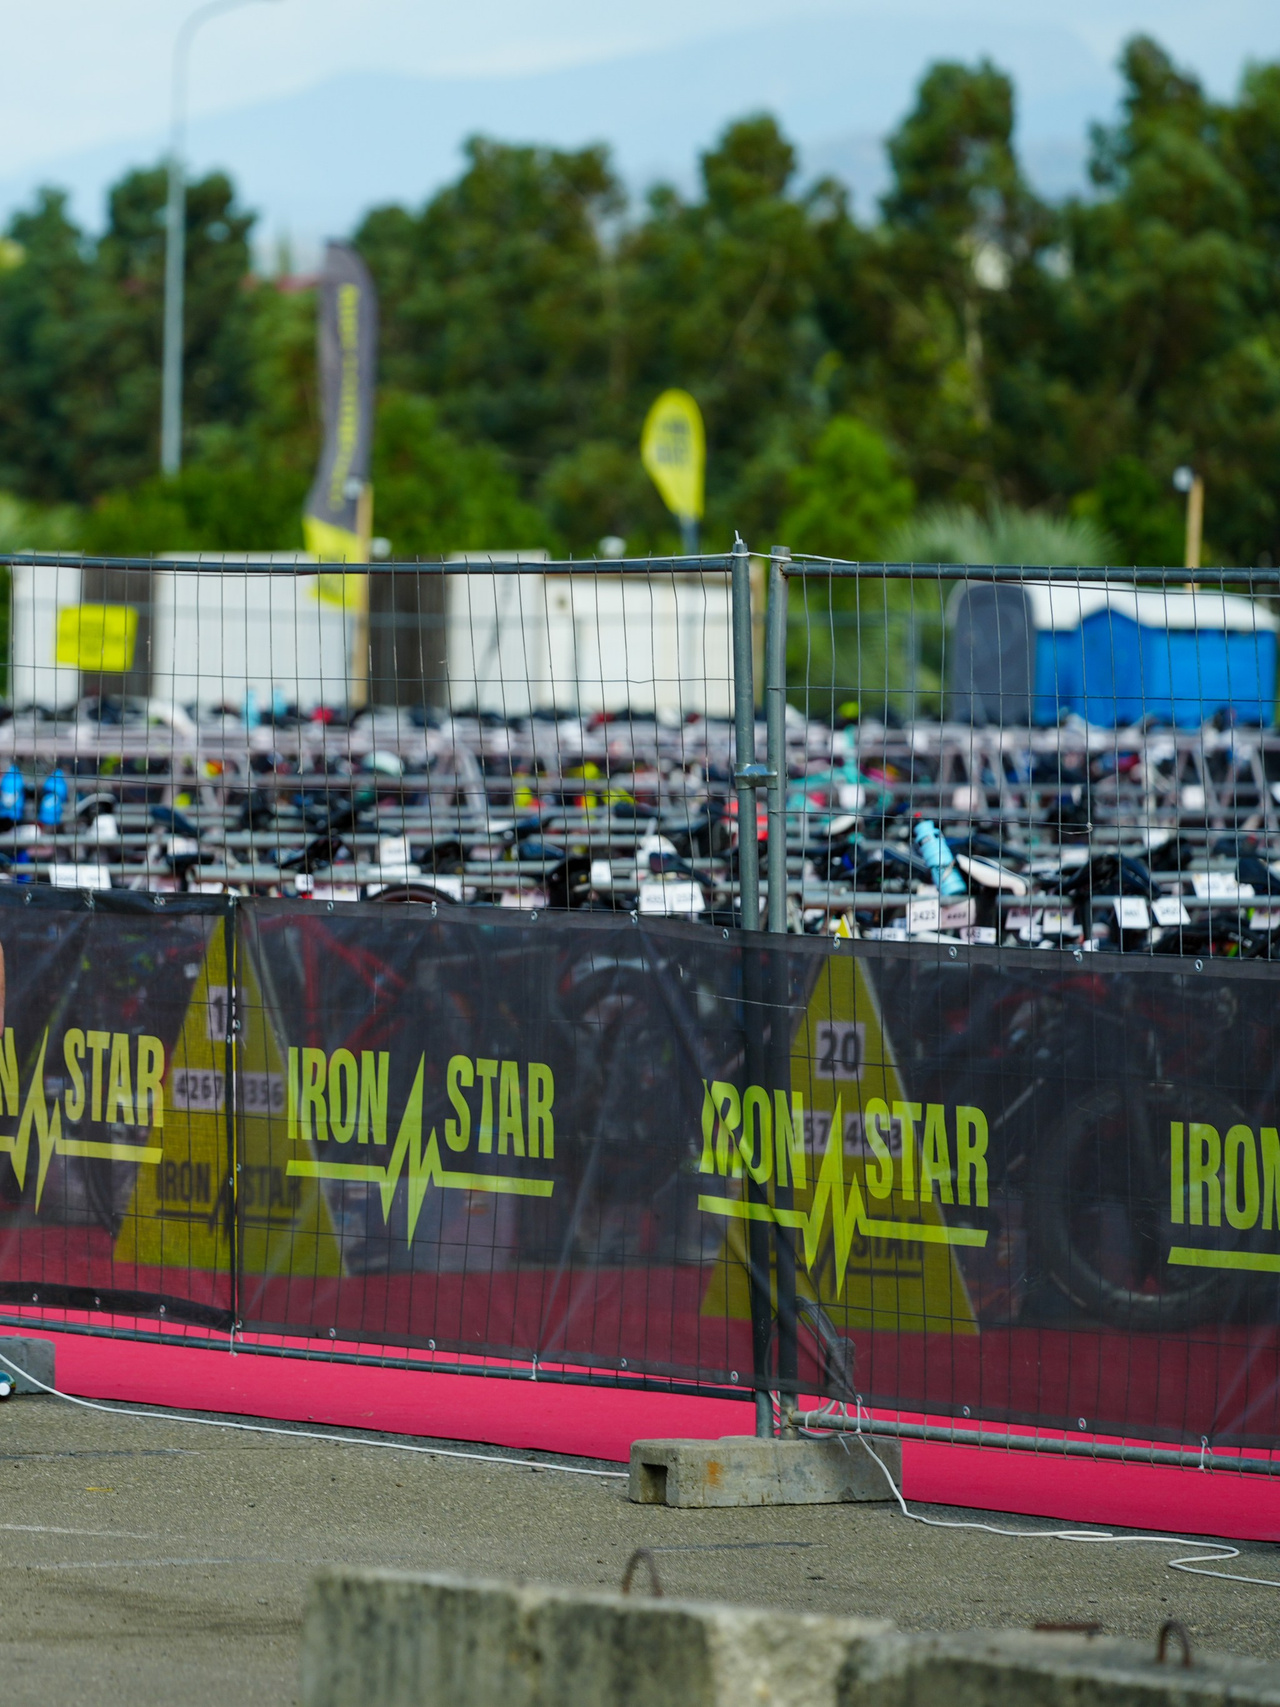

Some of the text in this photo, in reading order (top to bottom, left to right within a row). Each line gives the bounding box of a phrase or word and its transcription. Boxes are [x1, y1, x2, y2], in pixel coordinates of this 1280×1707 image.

[63, 1027, 165, 1128] STAR
[819, 1029, 862, 1073] 20
[287, 1046, 555, 1160] IRON STAR
[699, 1078, 990, 1209] IRON STAR
[156, 1158, 211, 1204] IRON
